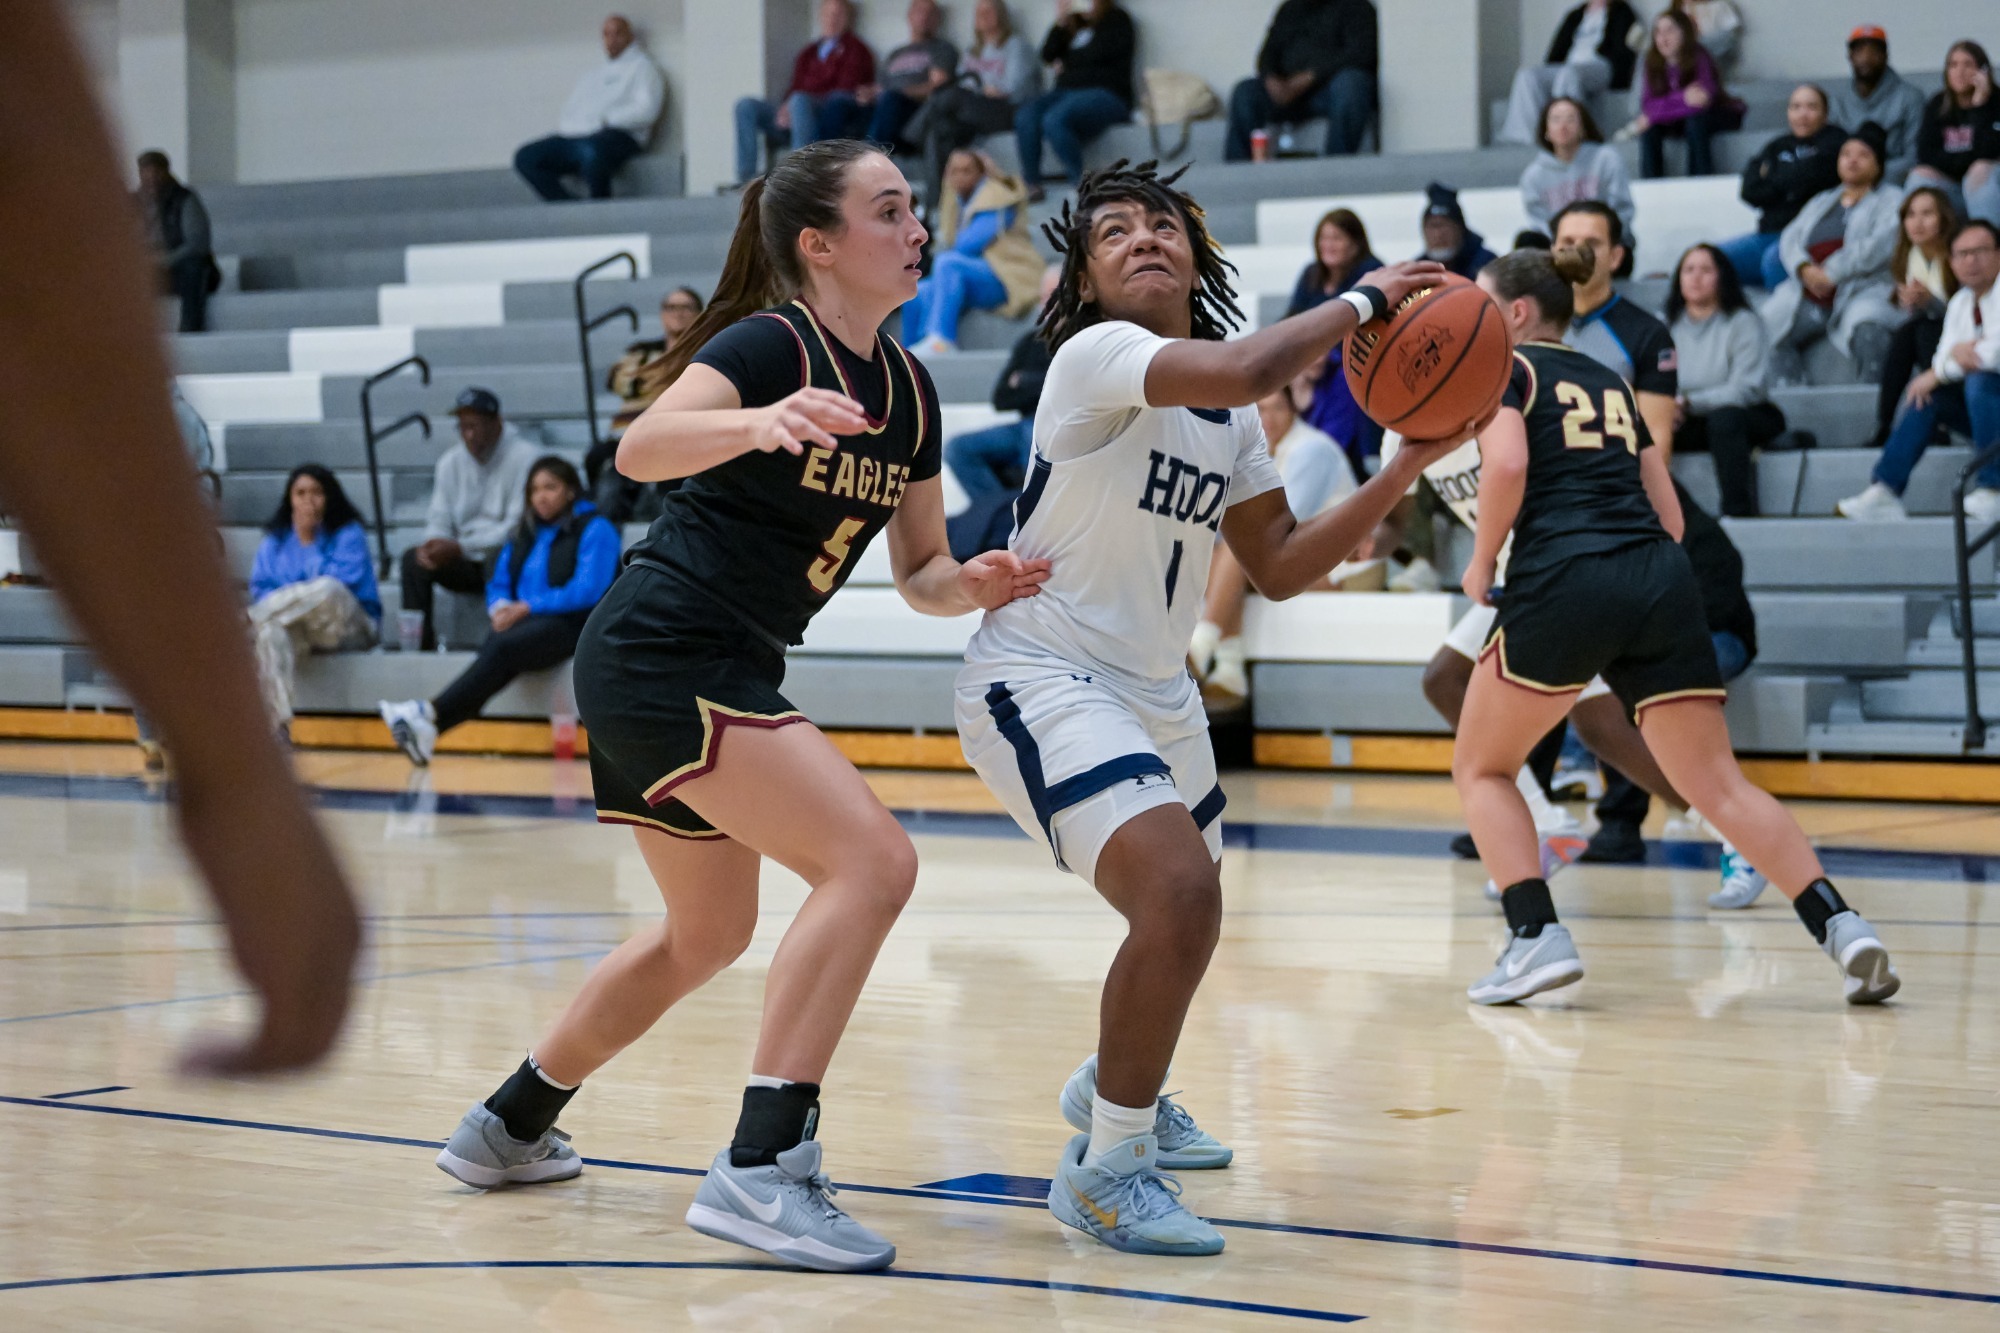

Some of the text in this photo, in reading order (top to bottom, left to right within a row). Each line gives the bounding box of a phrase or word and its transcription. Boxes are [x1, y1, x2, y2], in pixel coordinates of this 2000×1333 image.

[1554, 380, 1638, 457] 24
[799, 446, 911, 508] EAGLES
[1138, 449, 1231, 532] HOO
[806, 516, 867, 594] 5
[1165, 539, 1183, 615] 1
